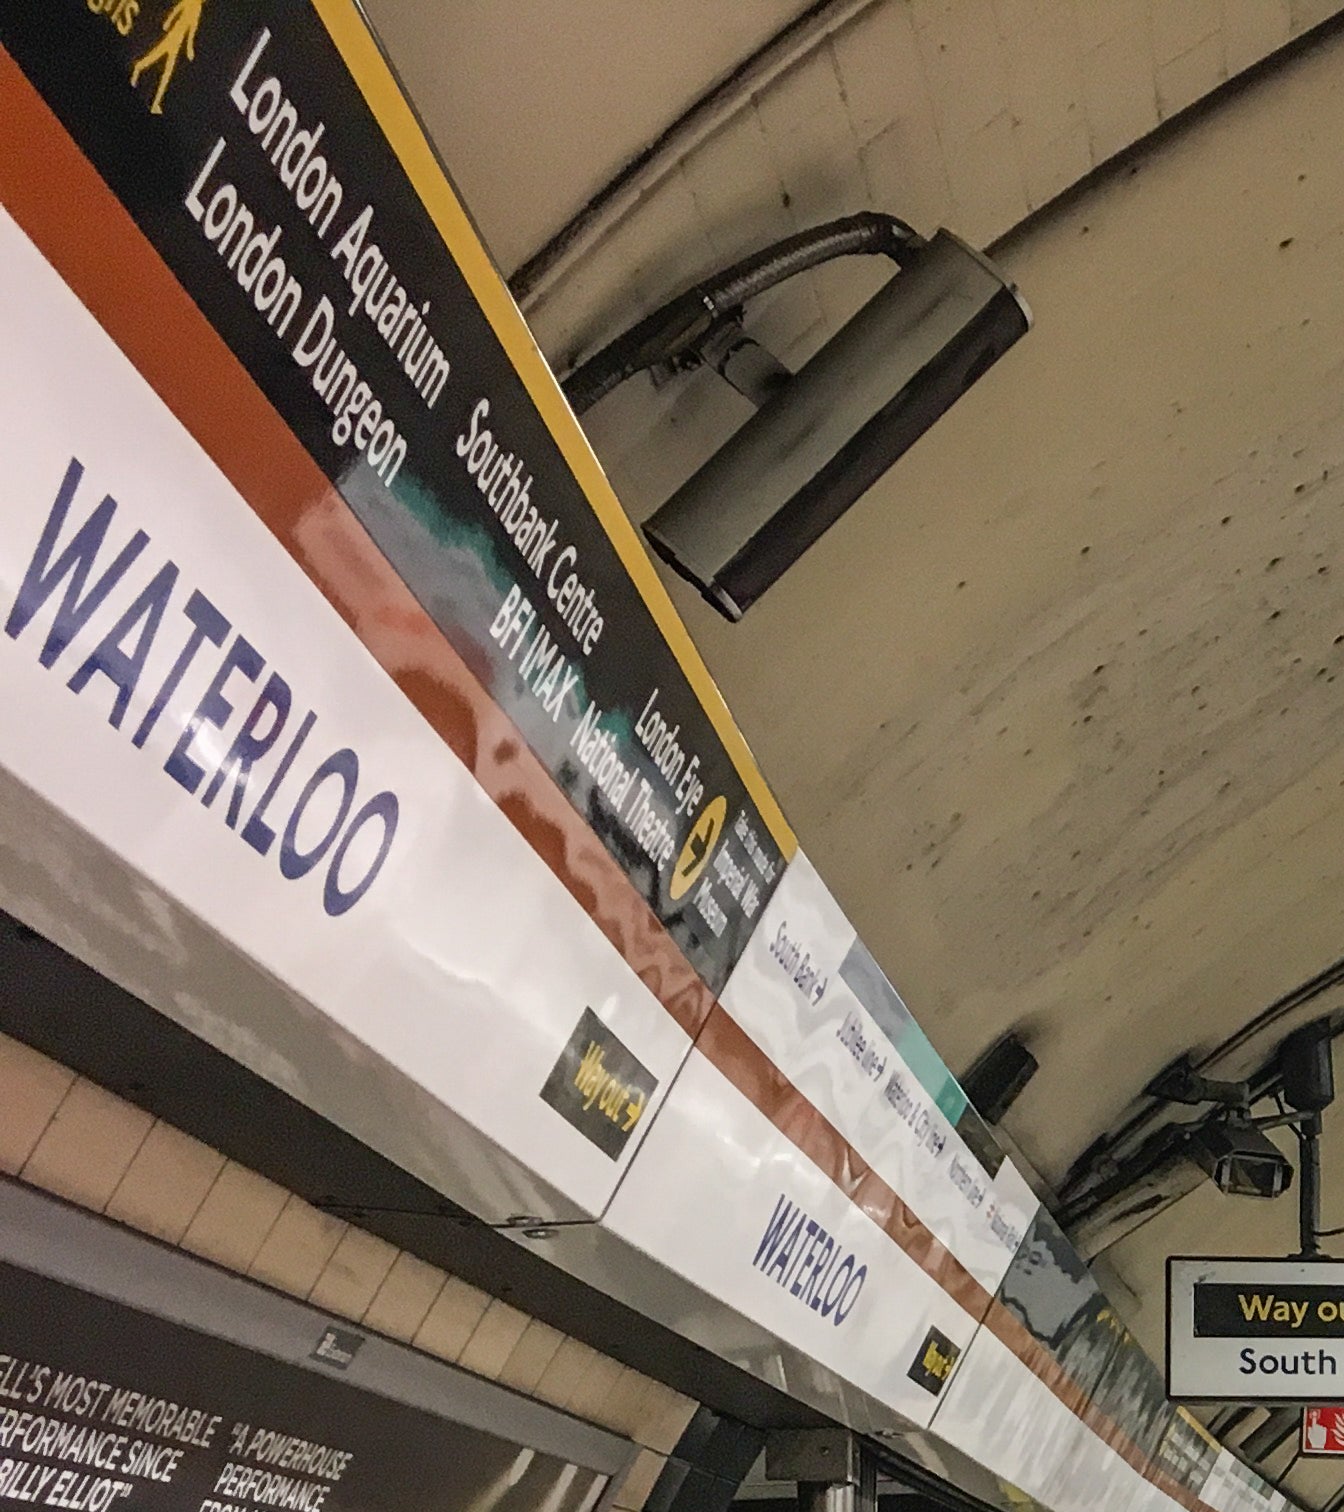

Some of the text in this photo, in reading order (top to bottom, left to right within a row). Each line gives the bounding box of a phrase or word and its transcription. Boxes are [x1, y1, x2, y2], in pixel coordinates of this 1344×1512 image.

[230, 27, 450, 408] London Aquarium
[185, 137, 407, 487] London Dungeon
[456, 398, 604, 655] Southbank Centre
[4, 456, 399, 917] WATERLOO
[489, 584, 579, 722] BFI IMAX
[570, 700, 675, 871] National Theatre
[634, 688, 704, 816] London Eye
[574, 1040, 630, 1123] Way out
[752, 1193, 868, 1327] WATERLOO
[1237, 1294, 1309, 1328] Way
[44, 1371, 112, 1418] MOST
[102, 1387, 223, 1448] MEMORABLE
[1239, 1347, 1337, 1375] South
[121, 1440, 184, 1482] SINCE
[244, 1428, 353, 1481] POWERHOUSE
